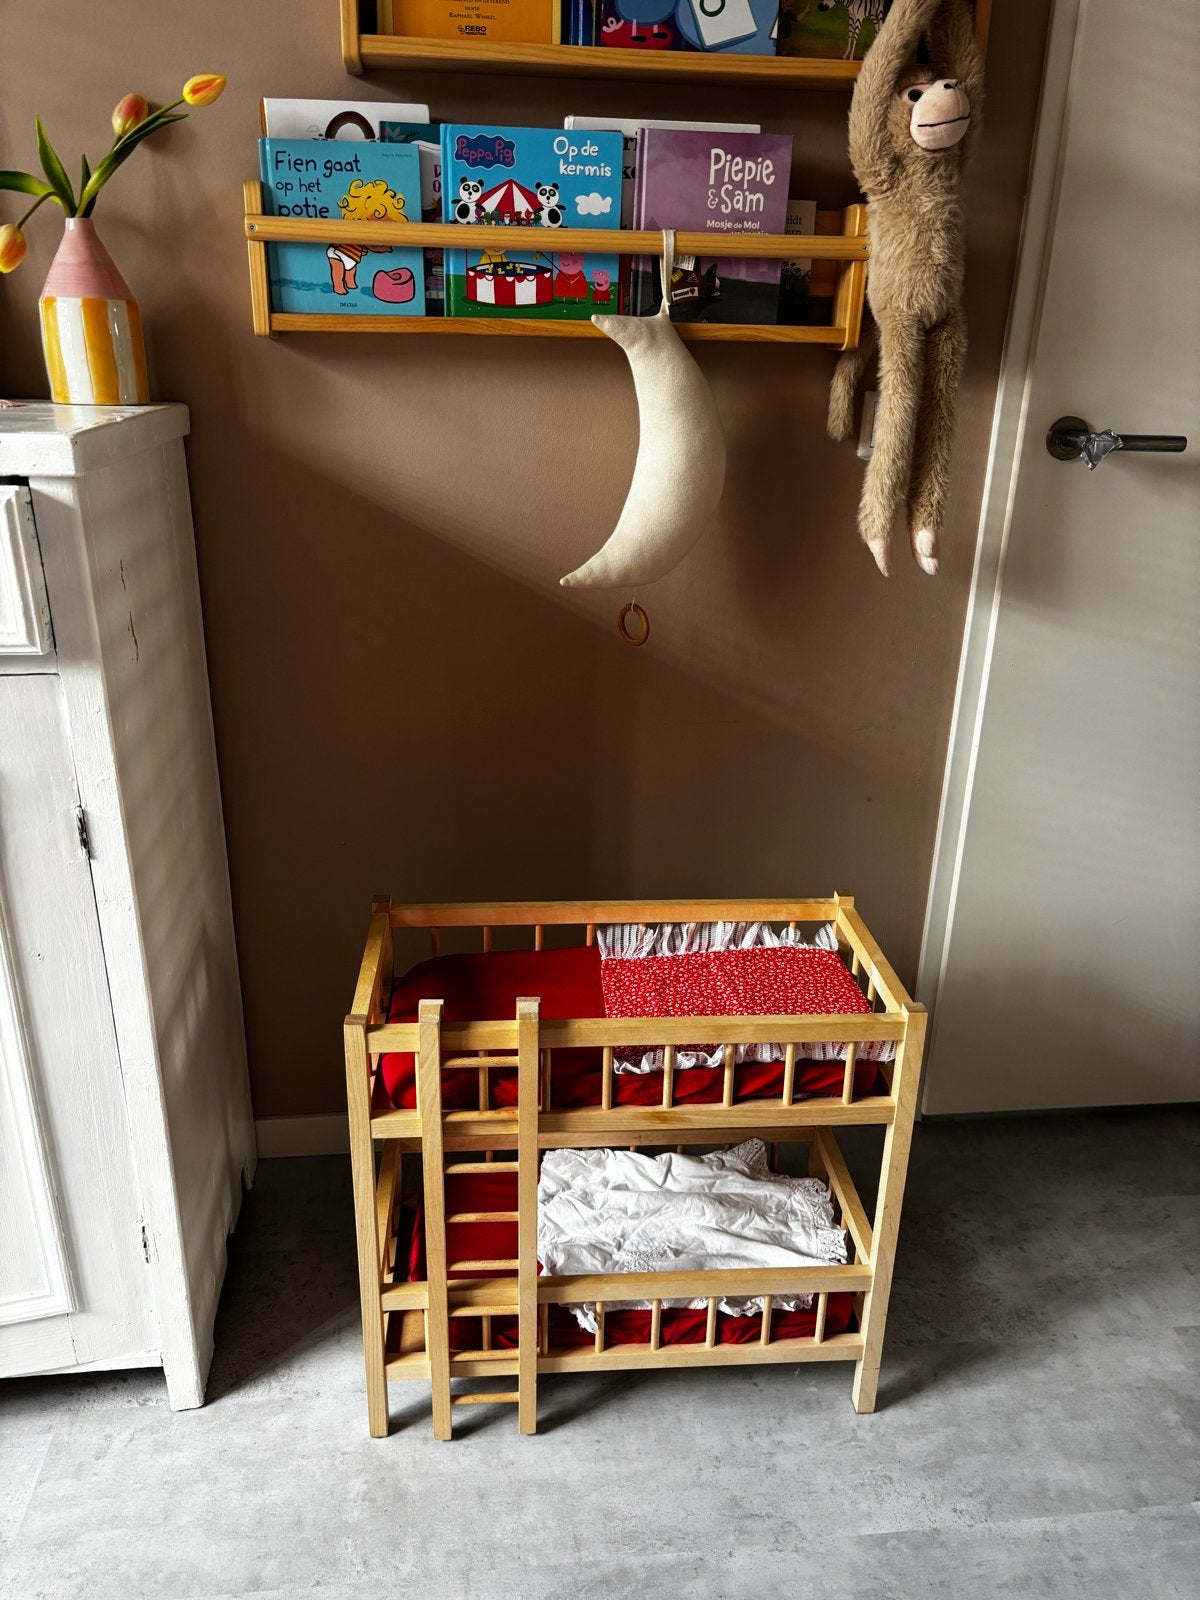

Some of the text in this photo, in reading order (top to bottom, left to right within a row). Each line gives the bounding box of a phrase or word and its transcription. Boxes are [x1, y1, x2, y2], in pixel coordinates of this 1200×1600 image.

[457, 137, 513, 164] Peppa Pig
[553, 136, 599, 162] Op de
[275, 150, 362, 178] Fien gaat
[559, 159, 612, 177] kermis
[709, 148, 776, 189] Piepie
[275, 177, 322, 196] op het
[707, 184, 764, 214] & Sam
[706, 219, 733, 230] Mosje
[743, 221, 760, 229] Mol
